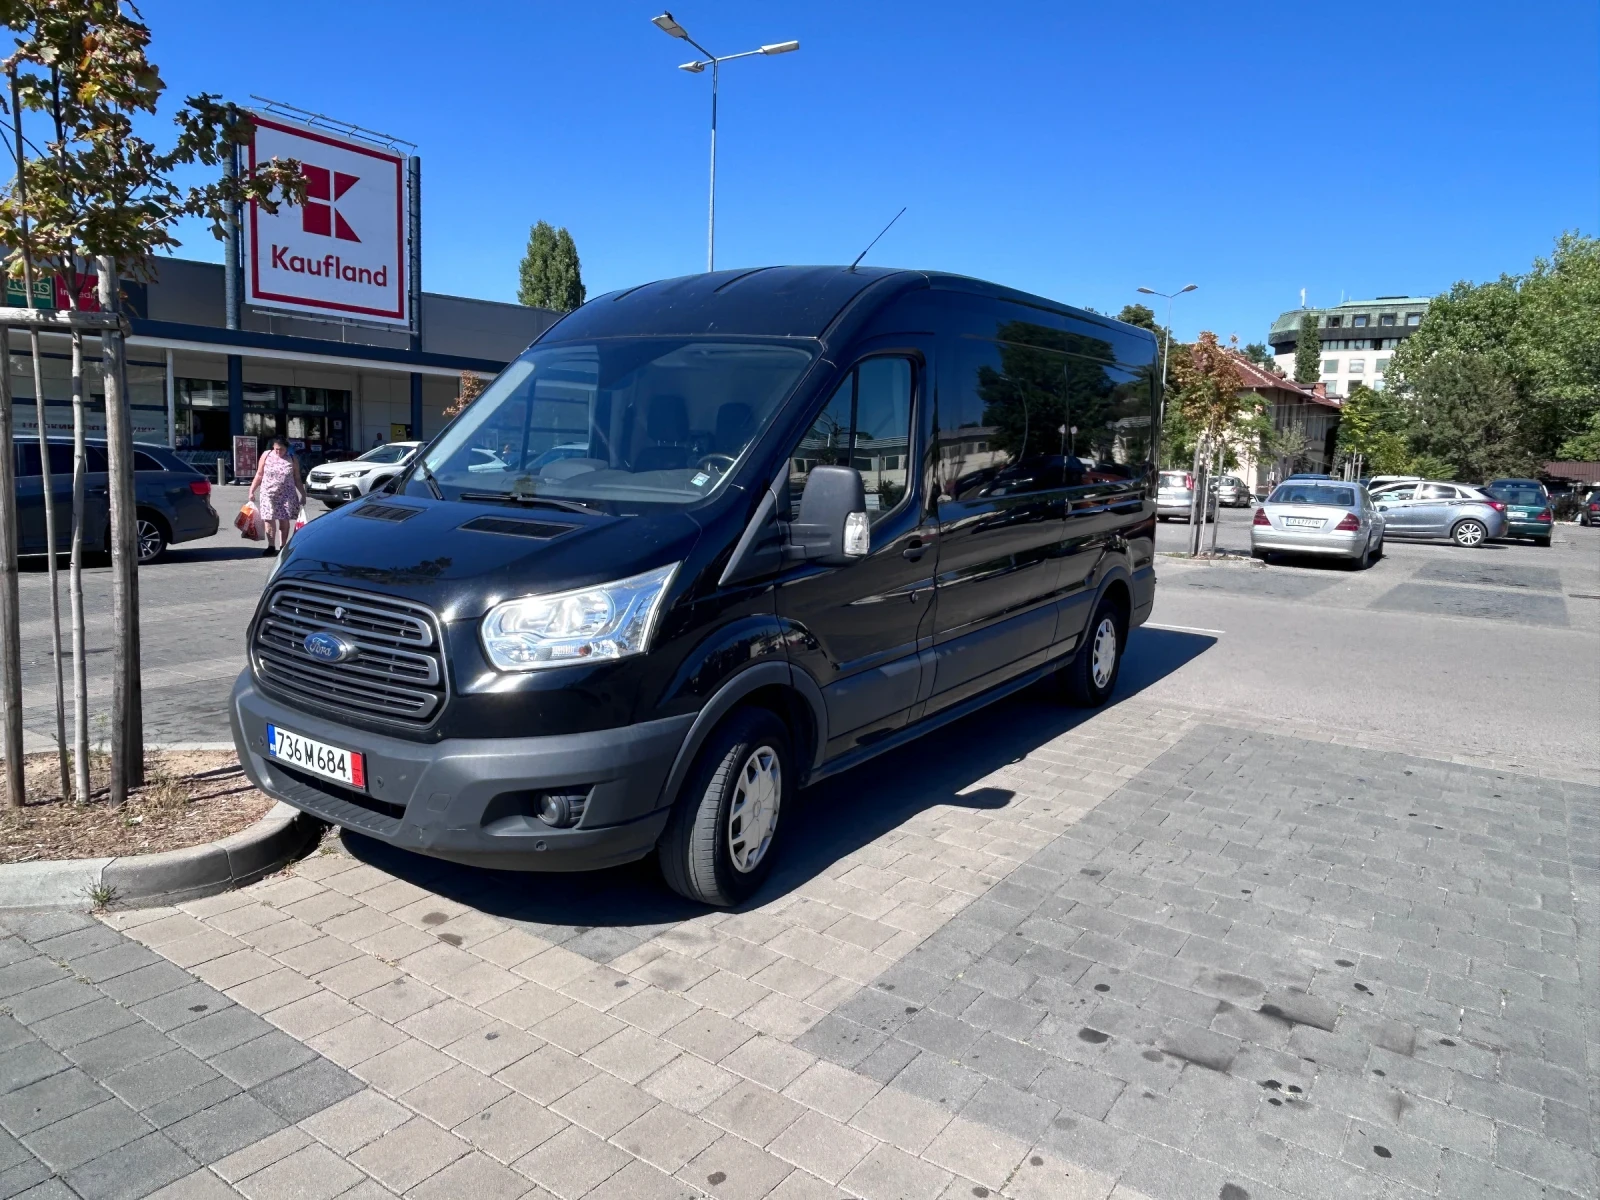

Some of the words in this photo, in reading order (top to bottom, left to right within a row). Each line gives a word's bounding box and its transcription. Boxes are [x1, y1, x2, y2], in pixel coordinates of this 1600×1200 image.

[271, 244, 387, 287] Kaufland
[310, 636, 332, 657] Ford
[276, 731, 346, 778] 736M684
